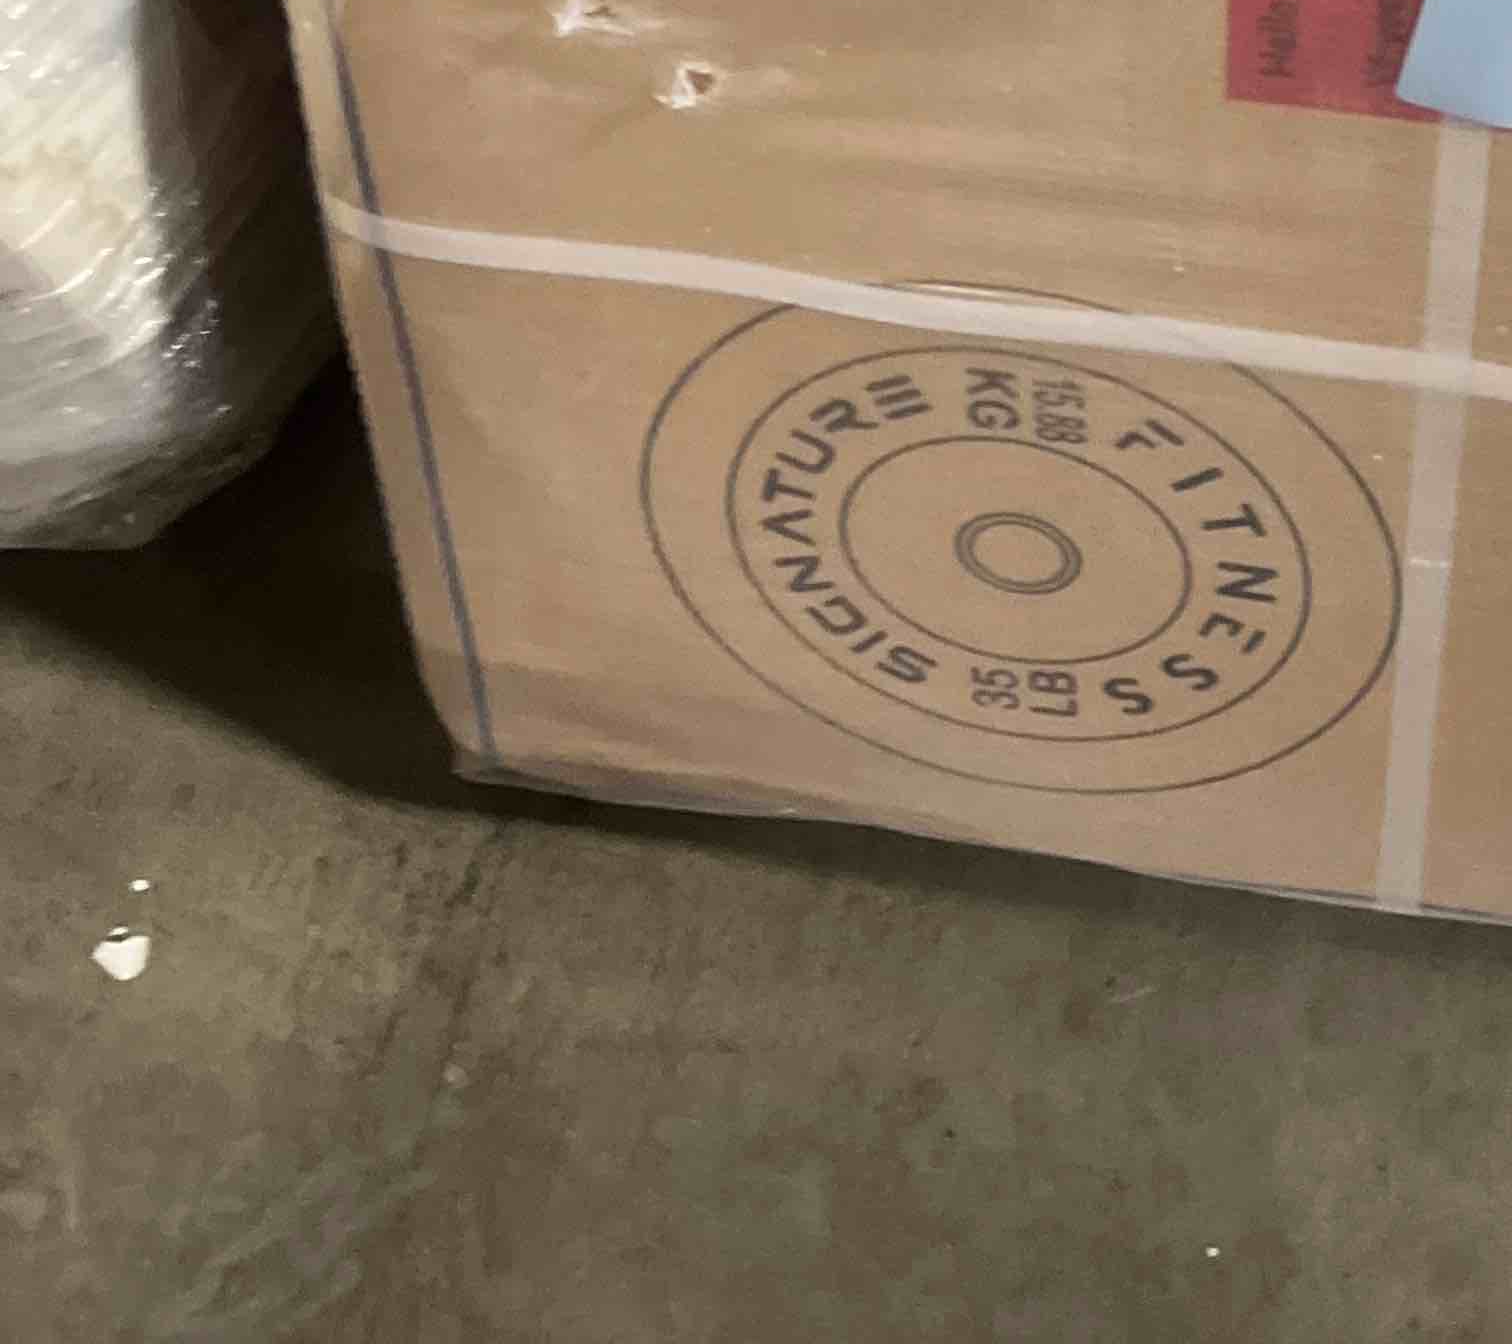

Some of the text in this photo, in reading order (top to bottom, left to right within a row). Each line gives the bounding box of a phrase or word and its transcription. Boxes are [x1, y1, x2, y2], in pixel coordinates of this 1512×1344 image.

[966, 368, 1020, 430] KG
[1031, 378, 1088, 447] 15.88
[762, 374, 937, 685] SIGNATURE
[1104, 420, 1279, 714] FITNESS
[970, 666, 1021, 711] 35
[1026, 671, 1080, 718] LB
